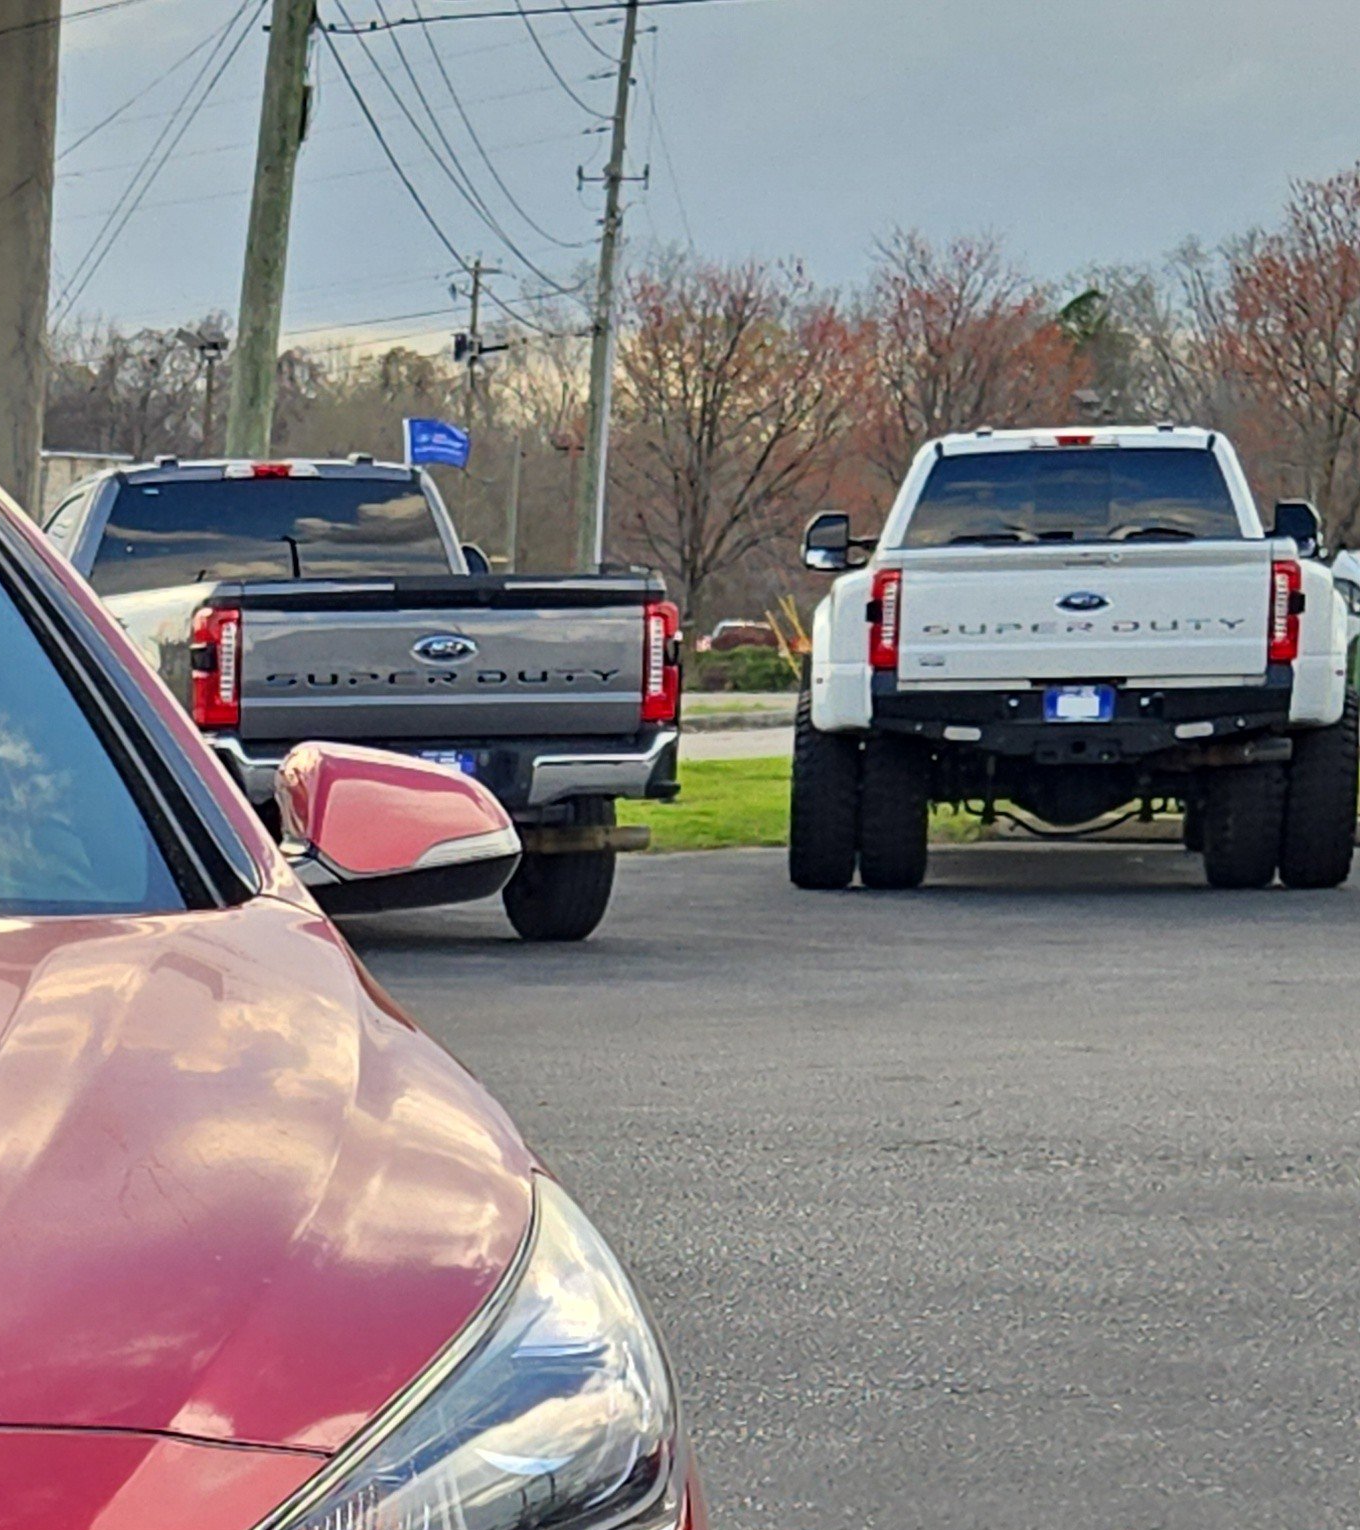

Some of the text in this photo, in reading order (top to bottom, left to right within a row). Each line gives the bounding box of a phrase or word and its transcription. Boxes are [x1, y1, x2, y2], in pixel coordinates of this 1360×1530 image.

[922, 617, 1245, 636] SUPER DUTY
[265, 668, 621, 688] SUPER DUTY
